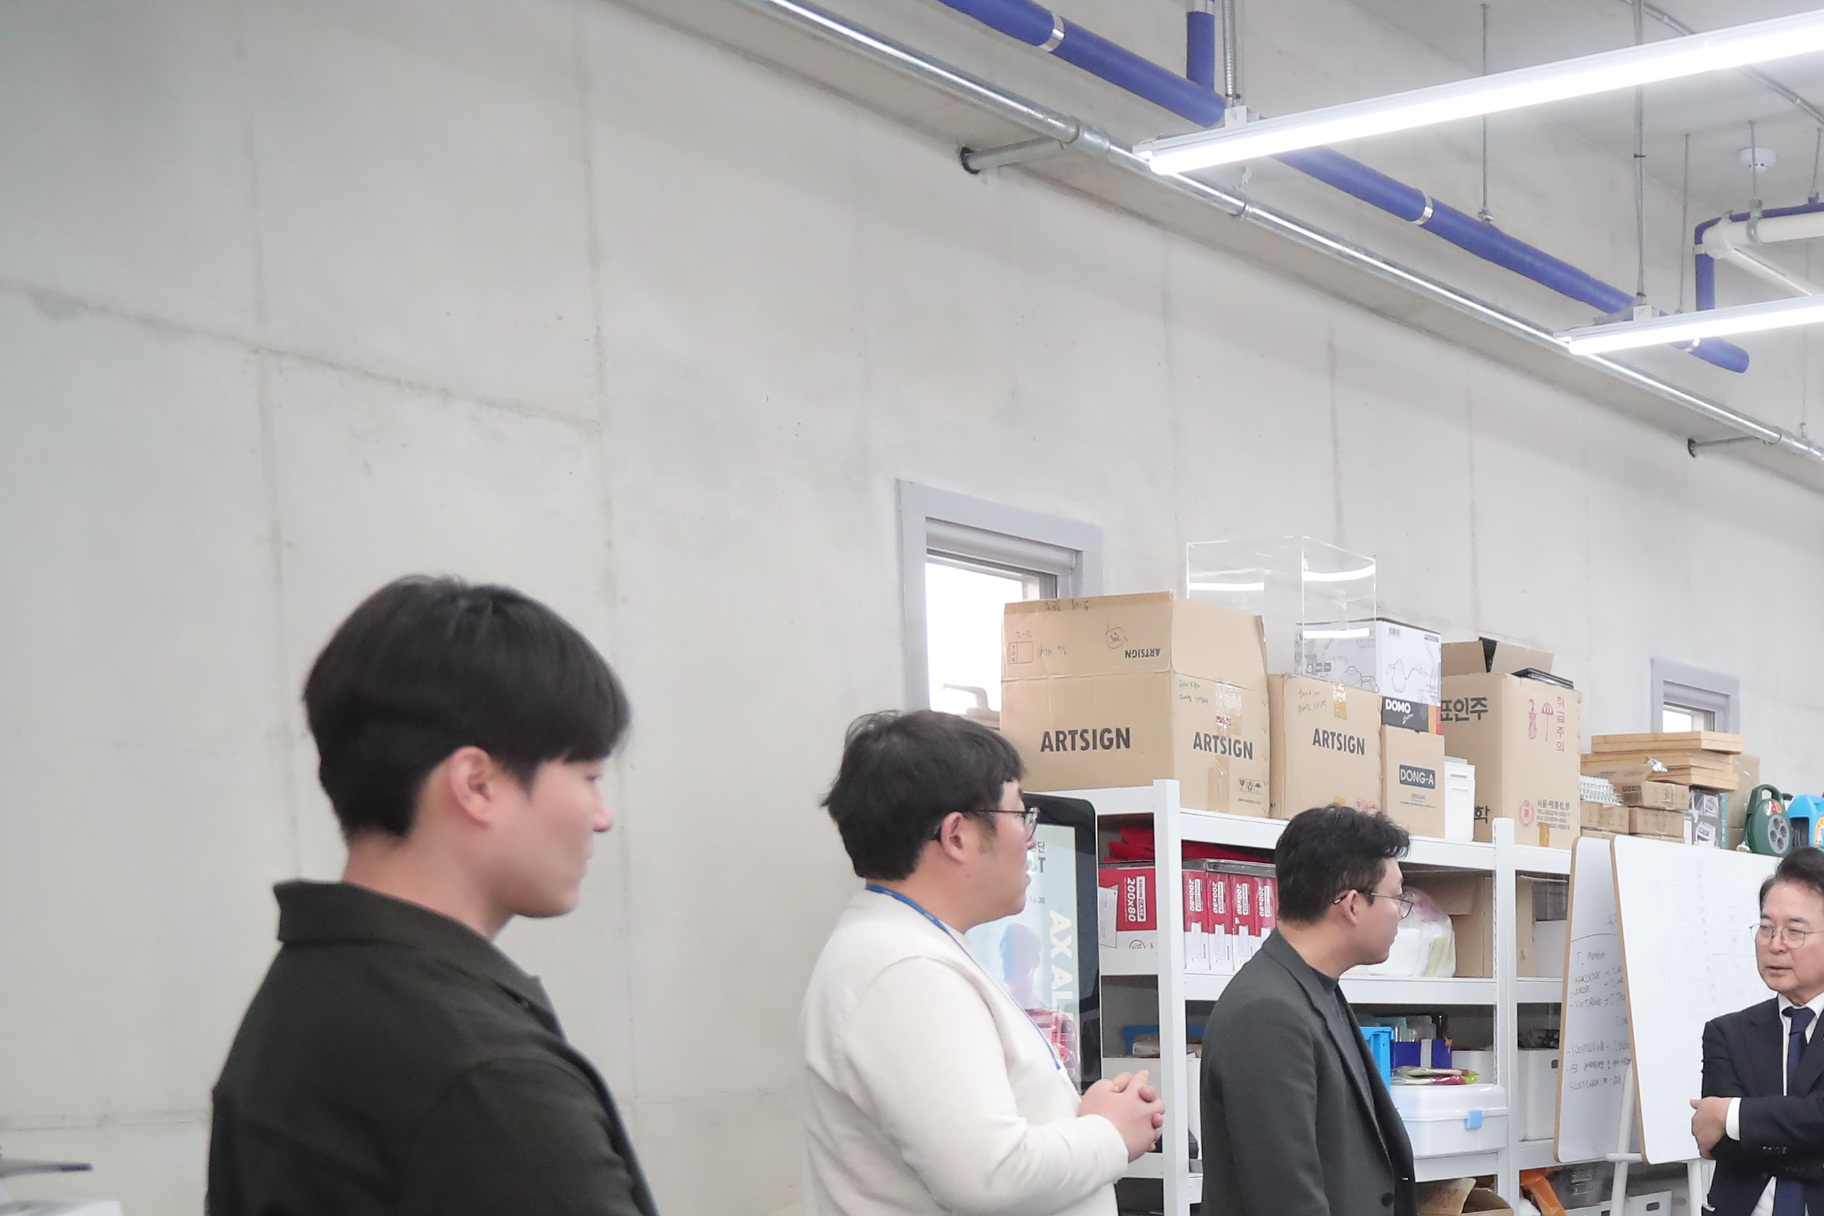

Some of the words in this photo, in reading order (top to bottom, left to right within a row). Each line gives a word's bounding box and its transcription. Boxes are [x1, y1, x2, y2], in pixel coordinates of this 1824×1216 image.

[1124, 648, 1161, 658] ARTSIGN
[1385, 698, 1411, 714] DOMO
[1556, 696, 1566, 753] 취급주의
[1040, 727, 1131, 753] ARTSIGN
[1193, 731, 1253, 760] ARTSIGN
[1312, 728, 1365, 756] ARTSIGN
[1400, 768, 1435, 786] DONG-A
[1127, 877, 1137, 922] 200x80
[1049, 909, 1073, 959] AX
